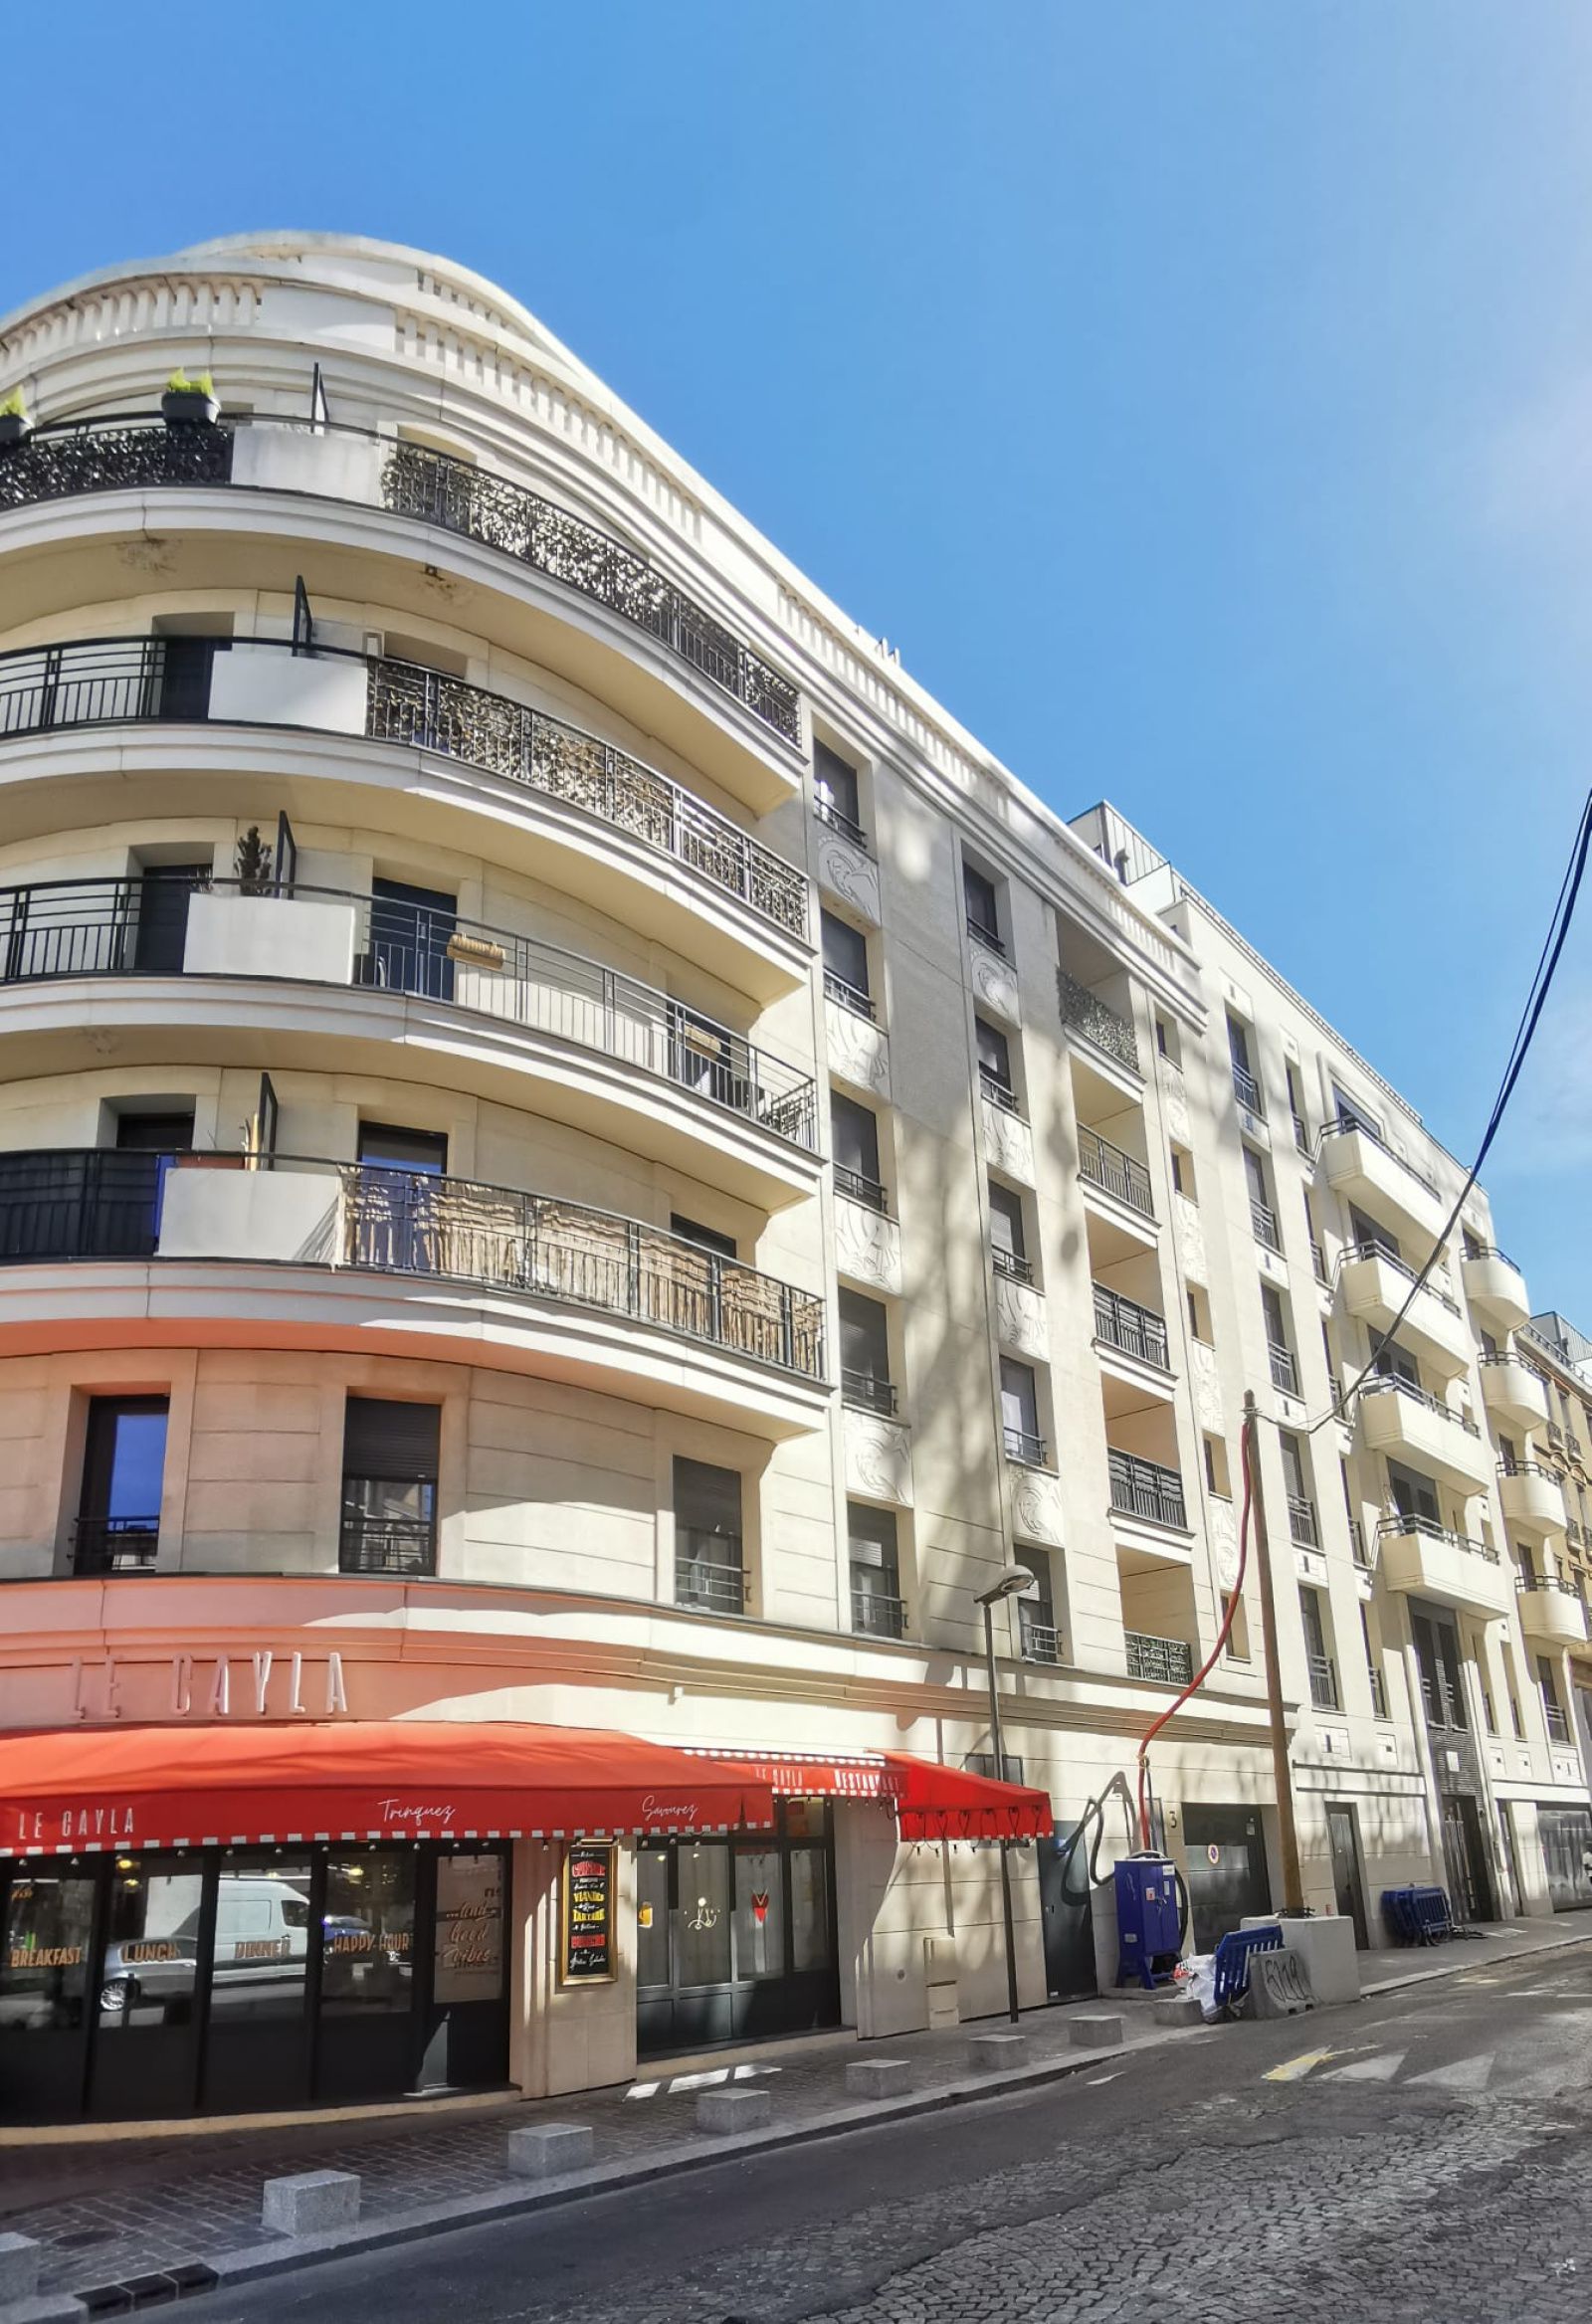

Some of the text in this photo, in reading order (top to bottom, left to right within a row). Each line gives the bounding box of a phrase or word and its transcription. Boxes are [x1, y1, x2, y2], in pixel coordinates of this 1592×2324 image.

[72, 1650, 348, 1718] LE CAYLA
[19, 1807, 133, 1840] LE CAYLA
[377, 1798, 457, 1827] Trinquez
[10, 1947, 82, 1967] BREAKFAST
[121, 1942, 178, 1963] LUNCH
